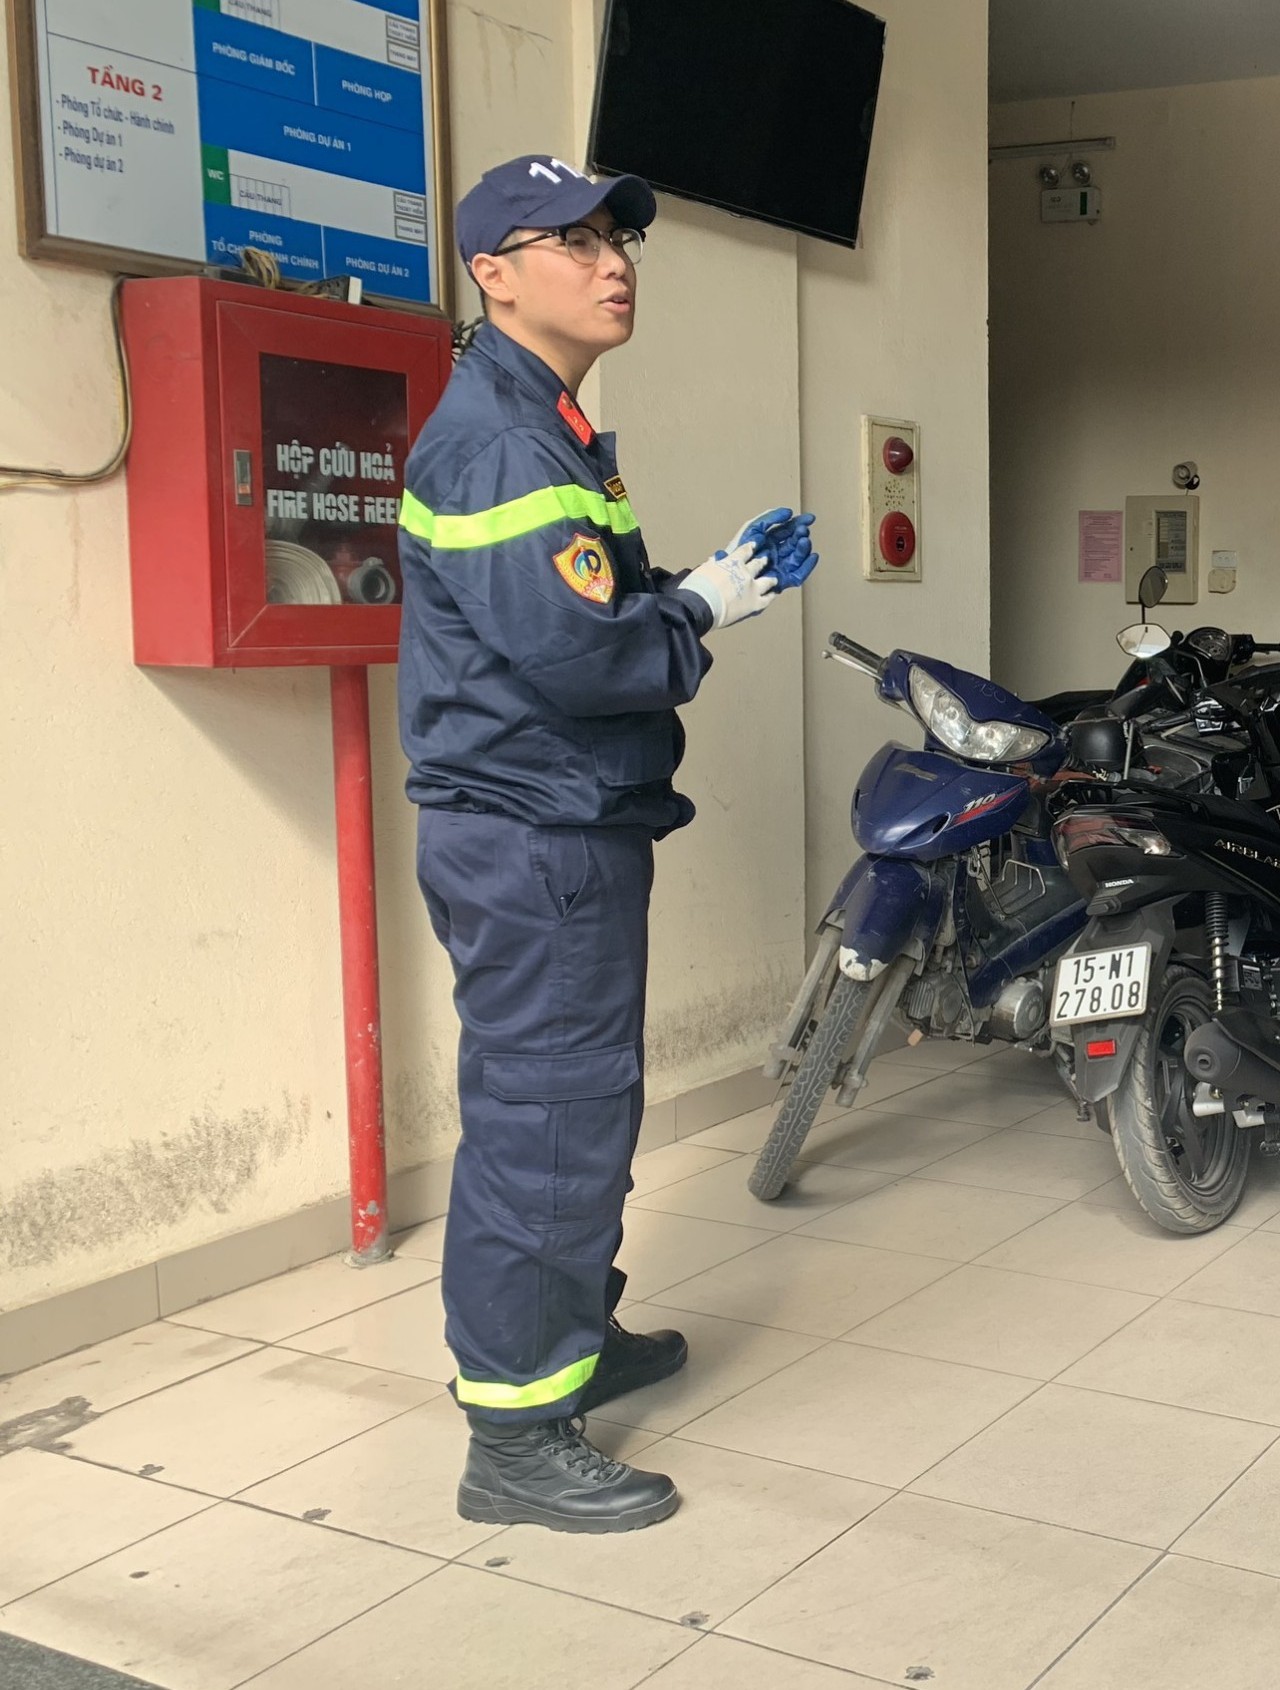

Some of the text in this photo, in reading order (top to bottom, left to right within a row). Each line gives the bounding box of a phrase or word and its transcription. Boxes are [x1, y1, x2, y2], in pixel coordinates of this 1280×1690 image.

[87, 65, 163, 102] TẦNG 2
[118, 158, 124, 173] 2
[207, 168, 225, 181] WC
[403, 268, 410, 278] 2
[267, 489, 308, 520] FIRE
[313, 492, 360, 523] HOSE
[963, 793, 997, 813] 110
[1104, 878, 1135, 888] HONDA
[1073, 950, 1135, 986] 15-N1
[1056, 981, 1140, 1018] 278.08
